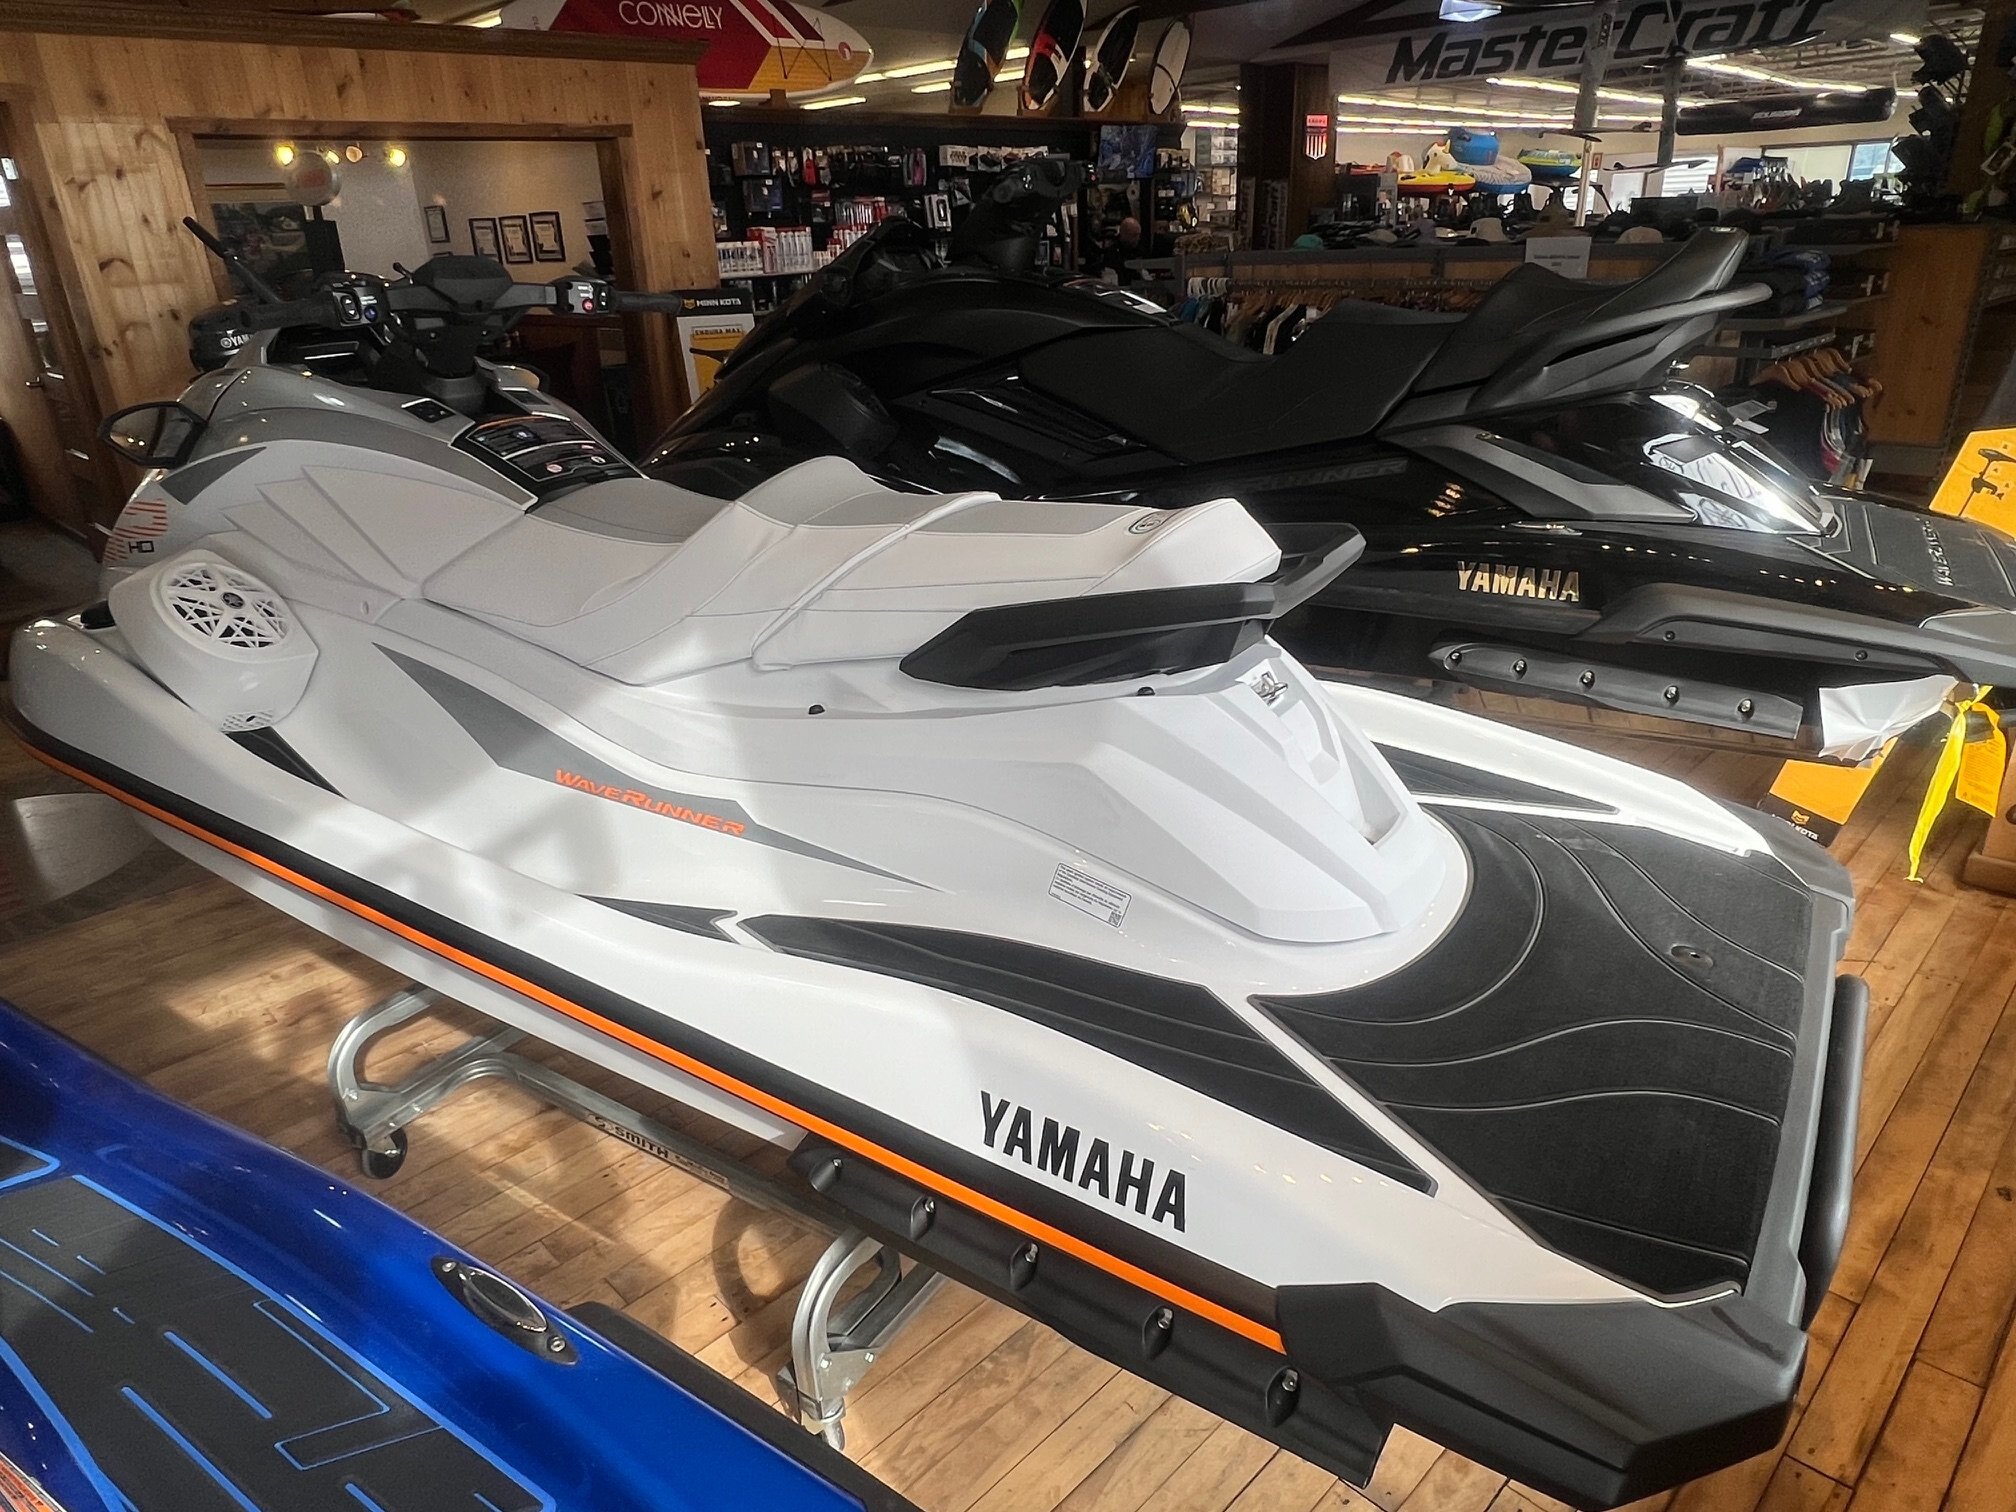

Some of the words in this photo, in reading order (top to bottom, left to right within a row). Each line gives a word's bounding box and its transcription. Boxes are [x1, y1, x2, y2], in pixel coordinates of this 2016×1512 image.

[1385, 0, 1833, 84] MasteCraft
[697, 299, 719, 308] MINN
[720, 297, 742, 306] KOTA
[1457, 560, 1579, 602] YAMAHA
[980, 1089, 1187, 1234] YAMAHA
